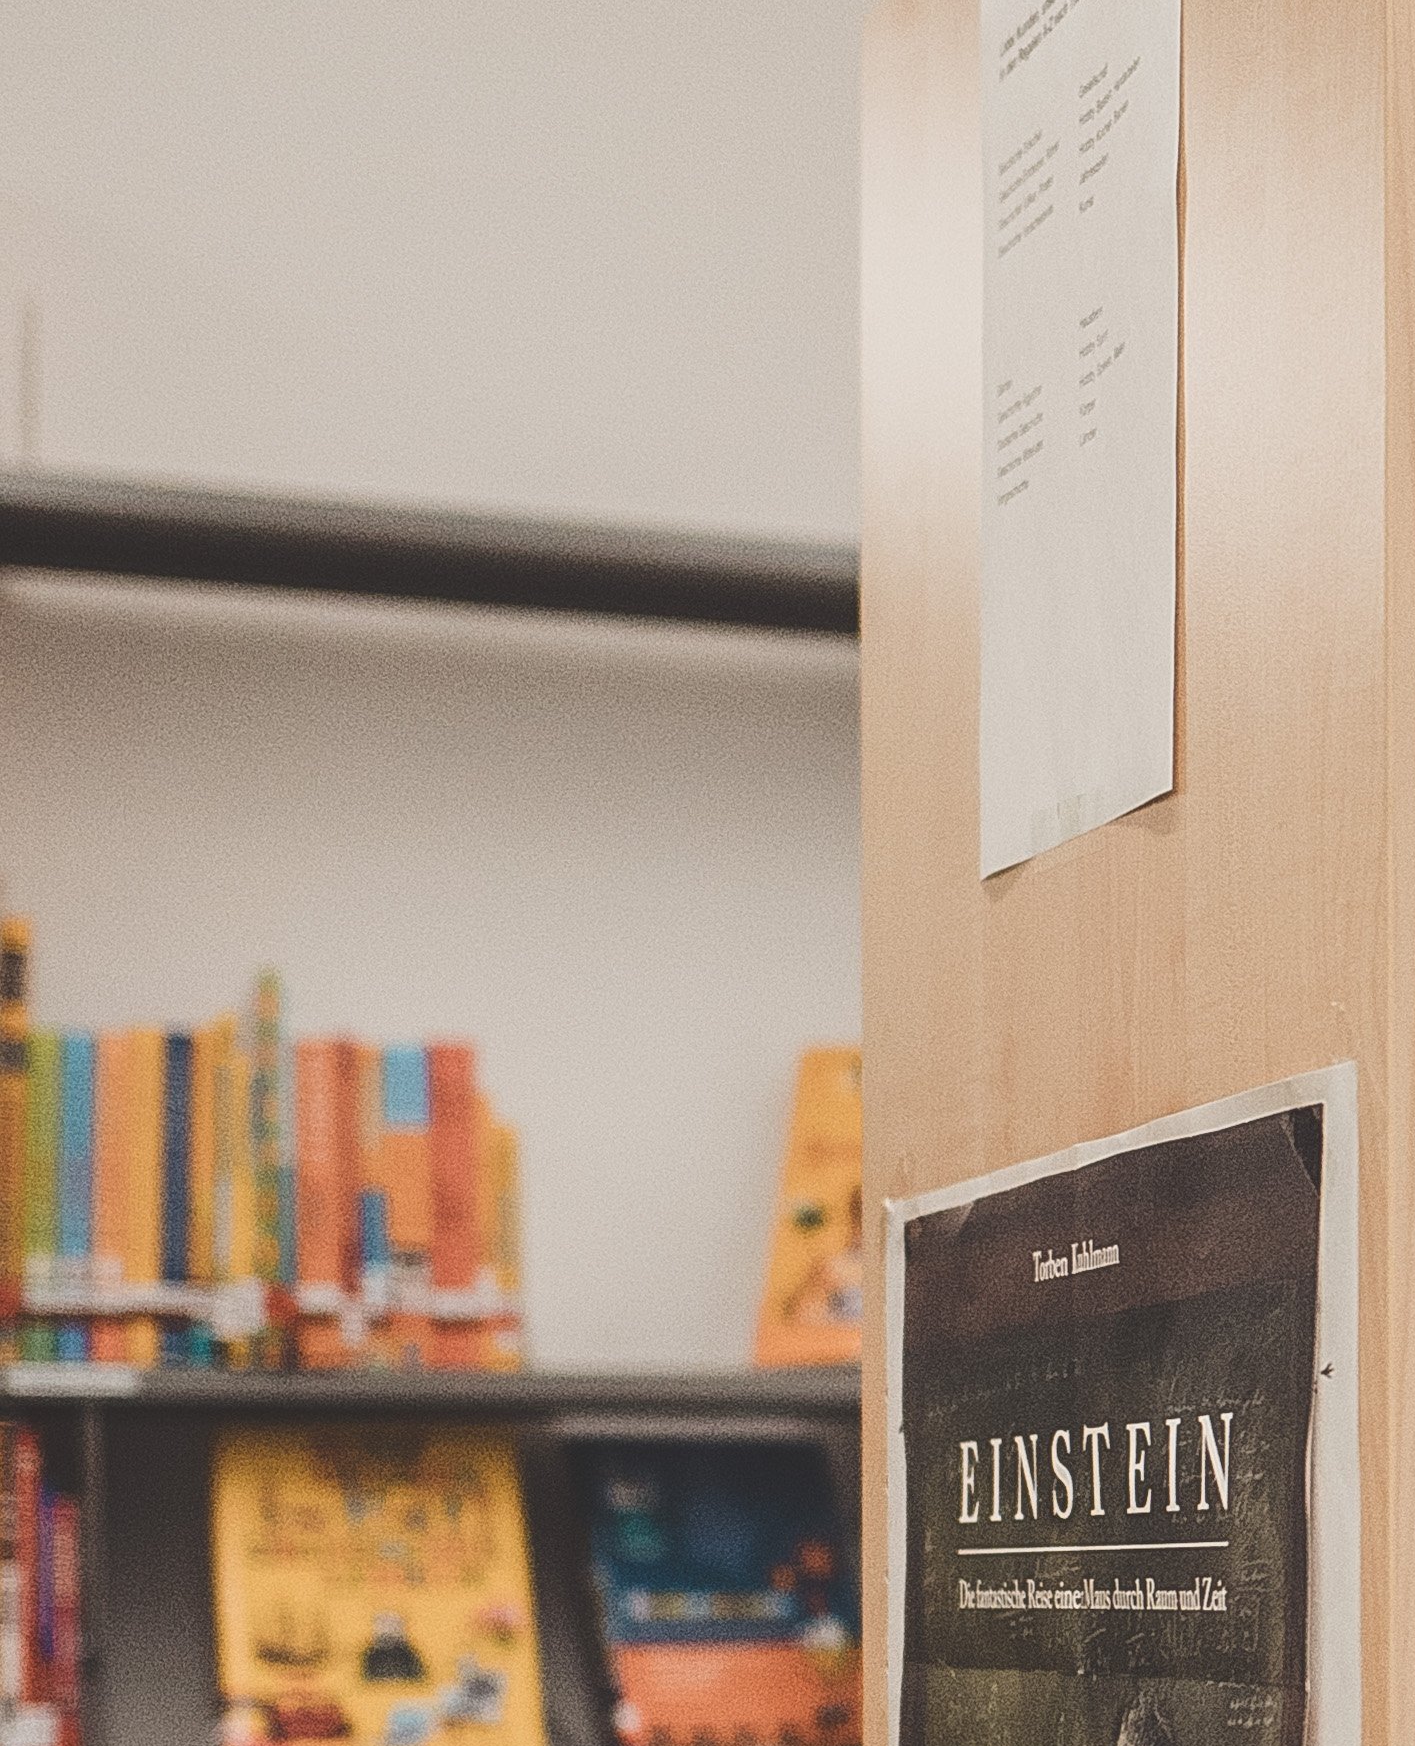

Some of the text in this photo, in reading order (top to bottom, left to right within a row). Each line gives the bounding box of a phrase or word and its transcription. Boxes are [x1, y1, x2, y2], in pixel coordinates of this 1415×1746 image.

[1033, 1240, 1119, 1282] Torben Kuhlmann
[958, 1412, 1234, 1524] EINSTEIN
[959, 1579, 975, 1609] Die
[976, 1579, 1026, 1609] fantastische
[1027, 1579, 1052, 1609] Reise
[1083, 1579, 1111, 1609] Maus
[1113, 1579, 1144, 1610] durch
[1146, 1578, 1178, 1610] Raum
[1179, 1577, 1201, 1610] und
[1202, 1577, 1227, 1611] Zeit
